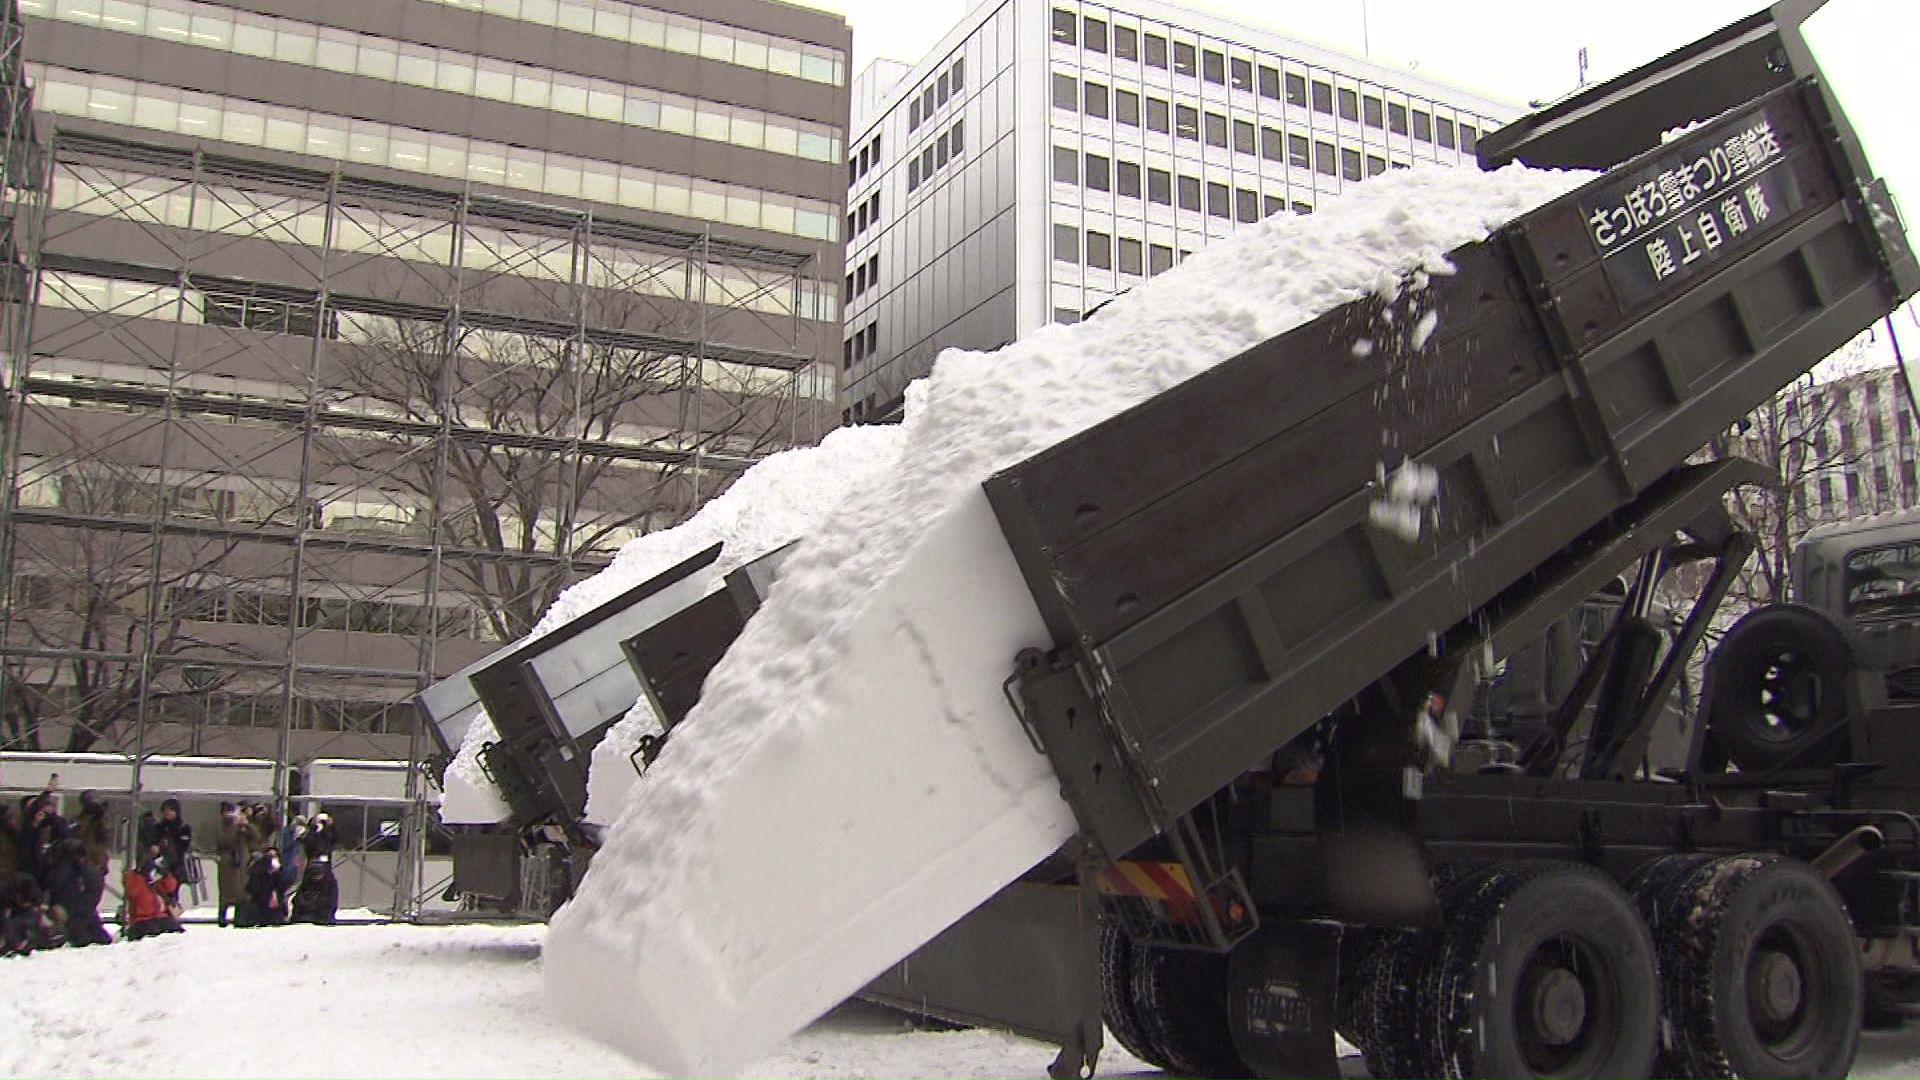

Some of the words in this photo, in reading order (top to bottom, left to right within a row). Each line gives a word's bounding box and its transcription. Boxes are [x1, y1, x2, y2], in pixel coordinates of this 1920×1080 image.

[1646, 182, 1770, 281] 陸上自衛隊
